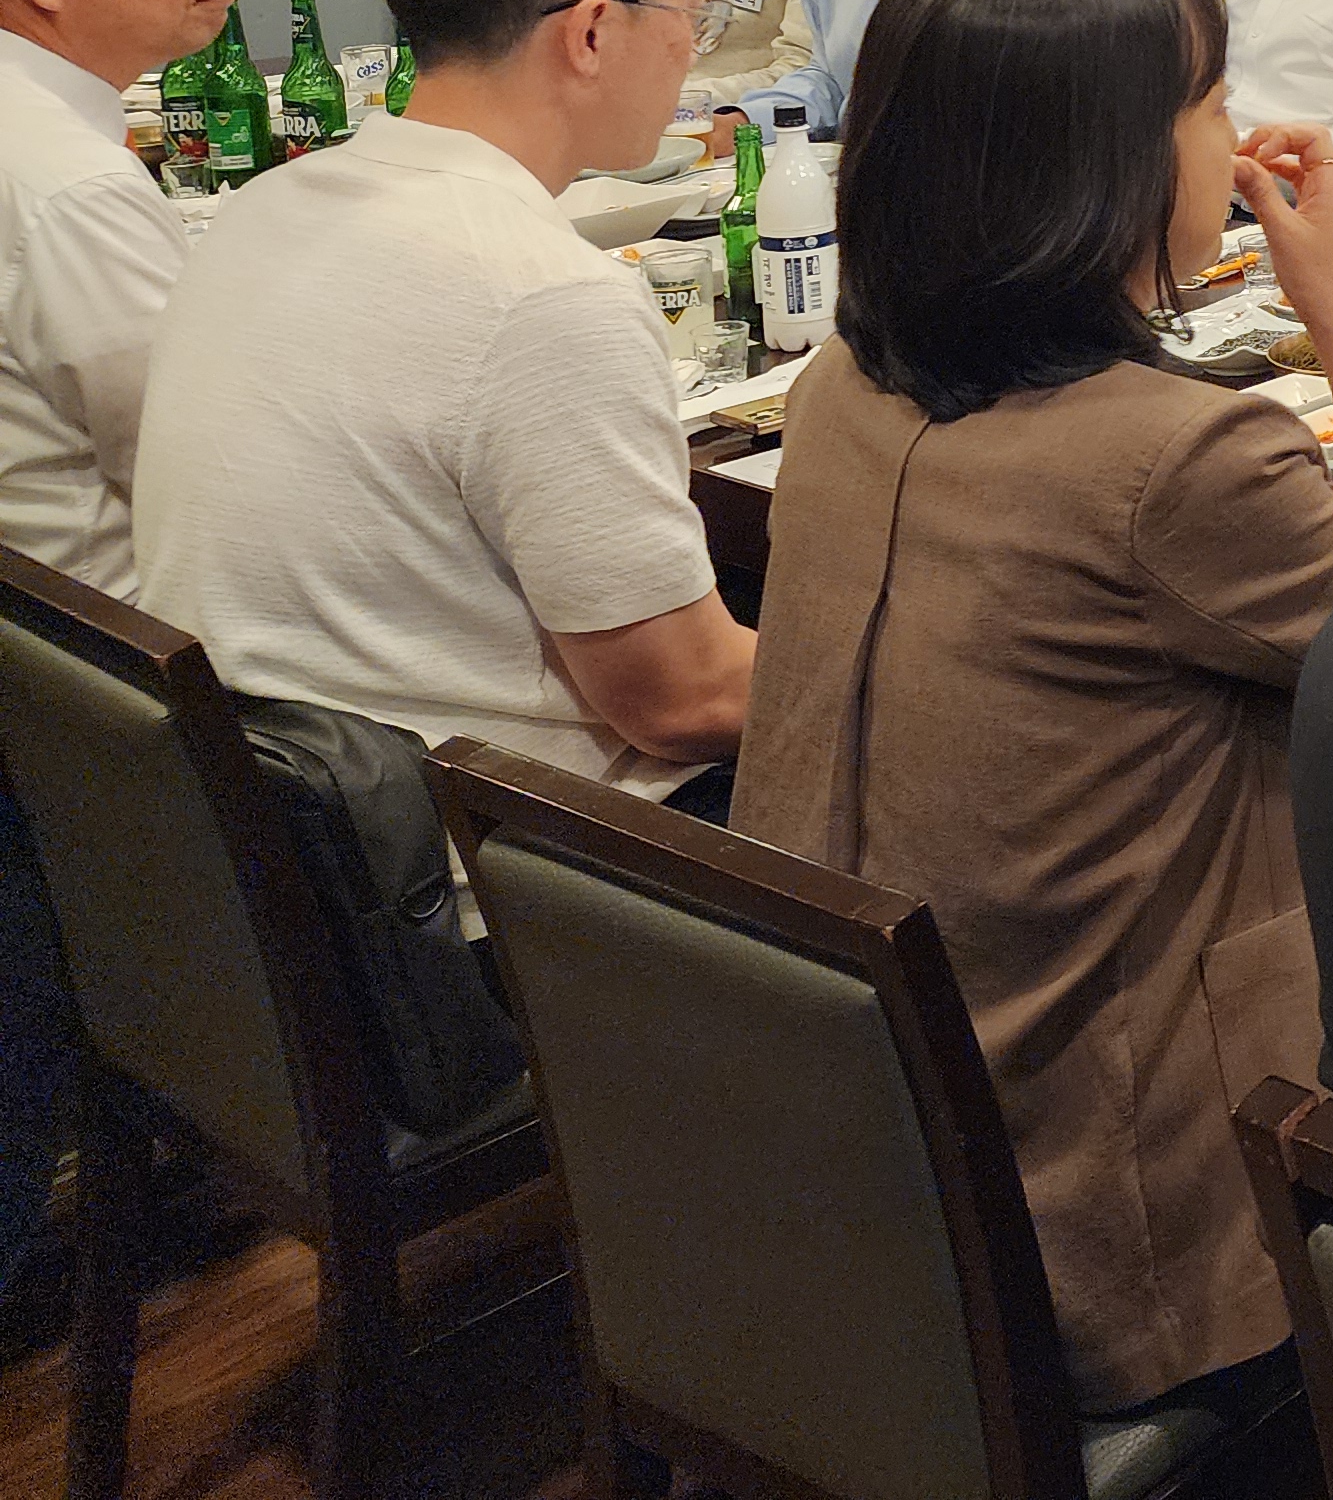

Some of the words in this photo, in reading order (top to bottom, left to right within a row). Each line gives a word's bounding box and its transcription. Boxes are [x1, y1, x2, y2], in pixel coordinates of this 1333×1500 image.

[161, 111, 207, 133] TERR
[283, 116, 321, 138] RRA
[658, 290, 702, 310] ERRA
